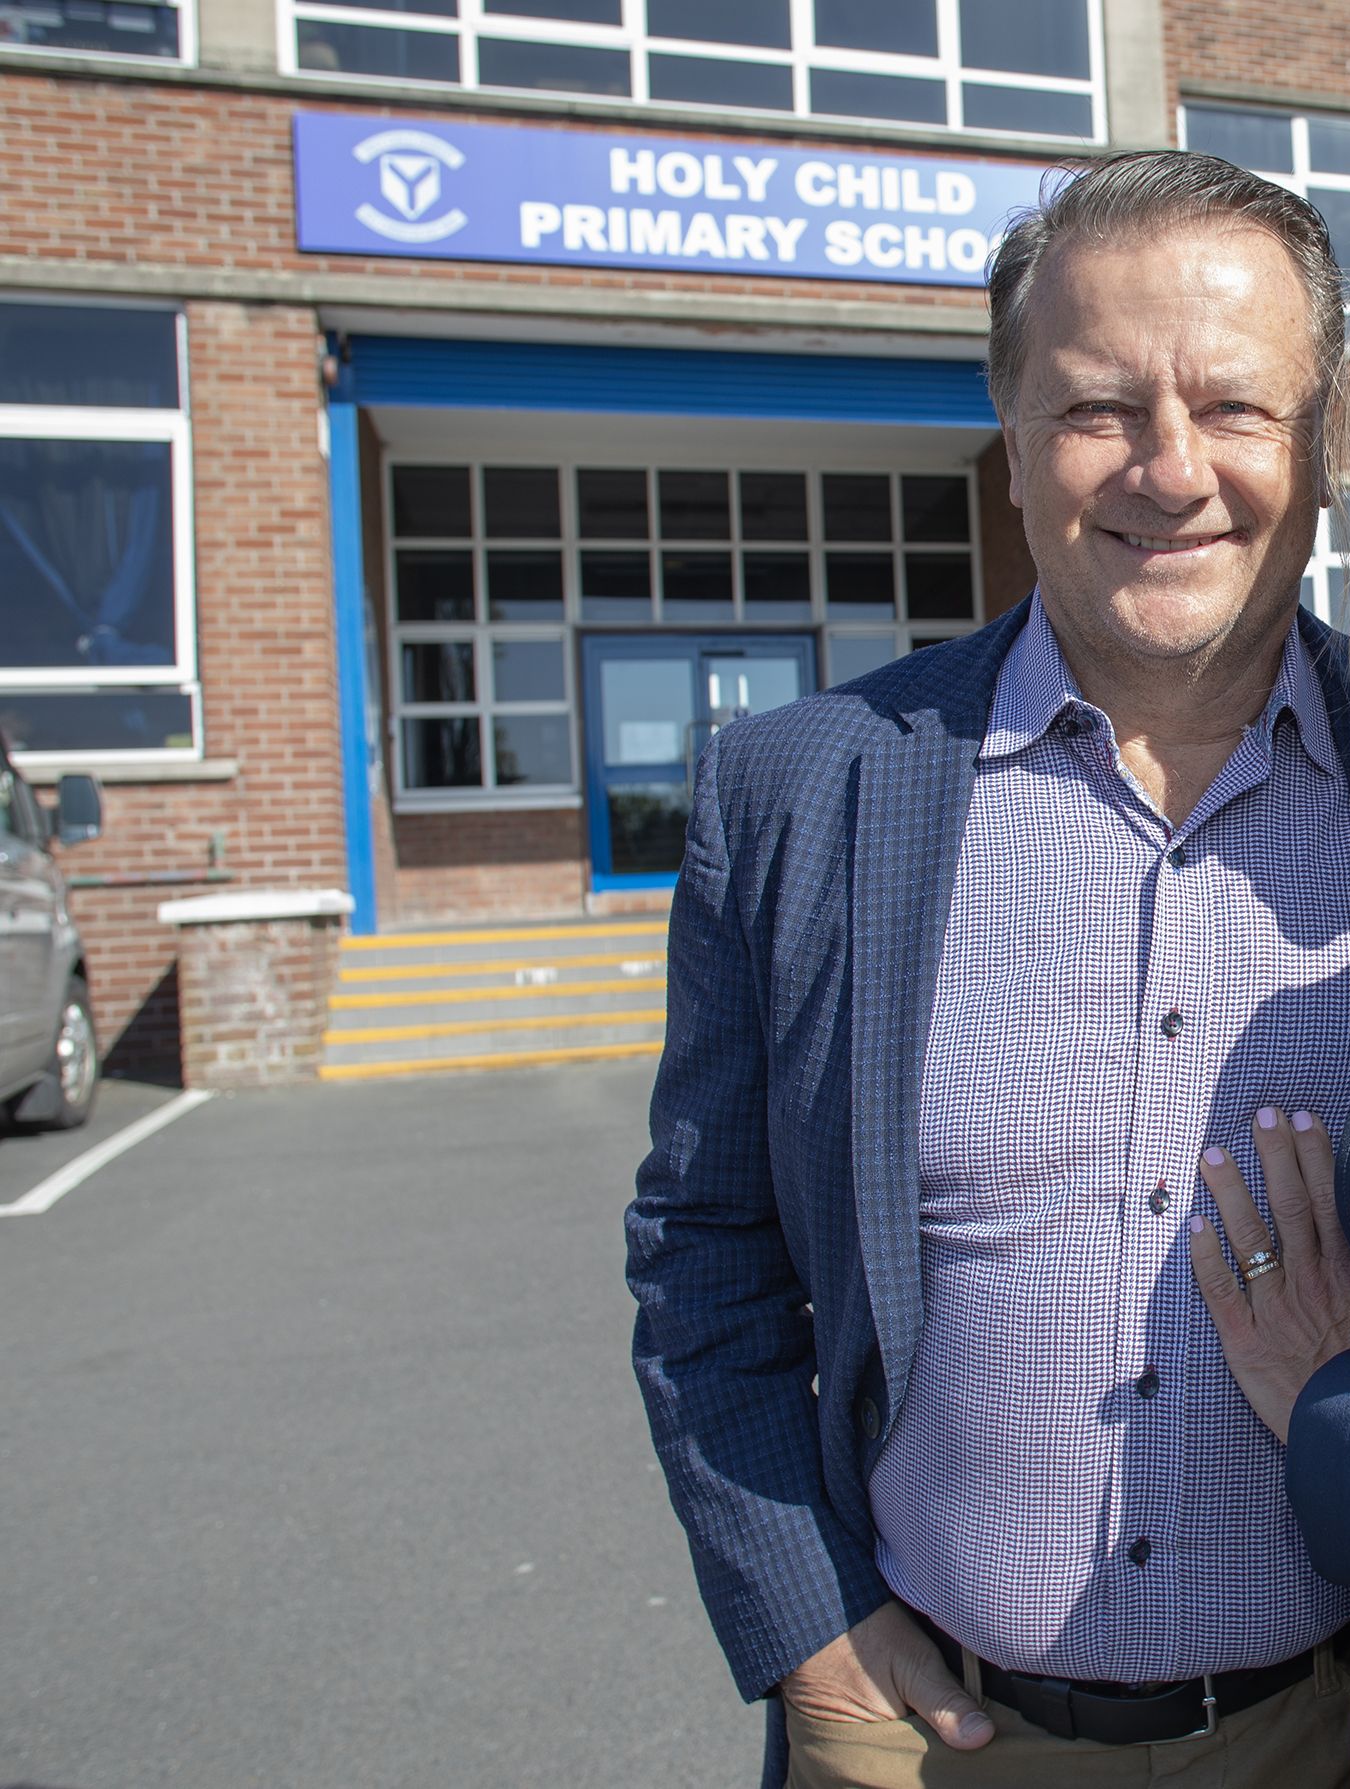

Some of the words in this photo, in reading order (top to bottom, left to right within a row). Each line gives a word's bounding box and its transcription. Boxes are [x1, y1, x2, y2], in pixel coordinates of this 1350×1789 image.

[610, 147, 778, 202] HOLY
[795, 161, 977, 216] CHILD
[520, 200, 809, 262] PRIMARY
